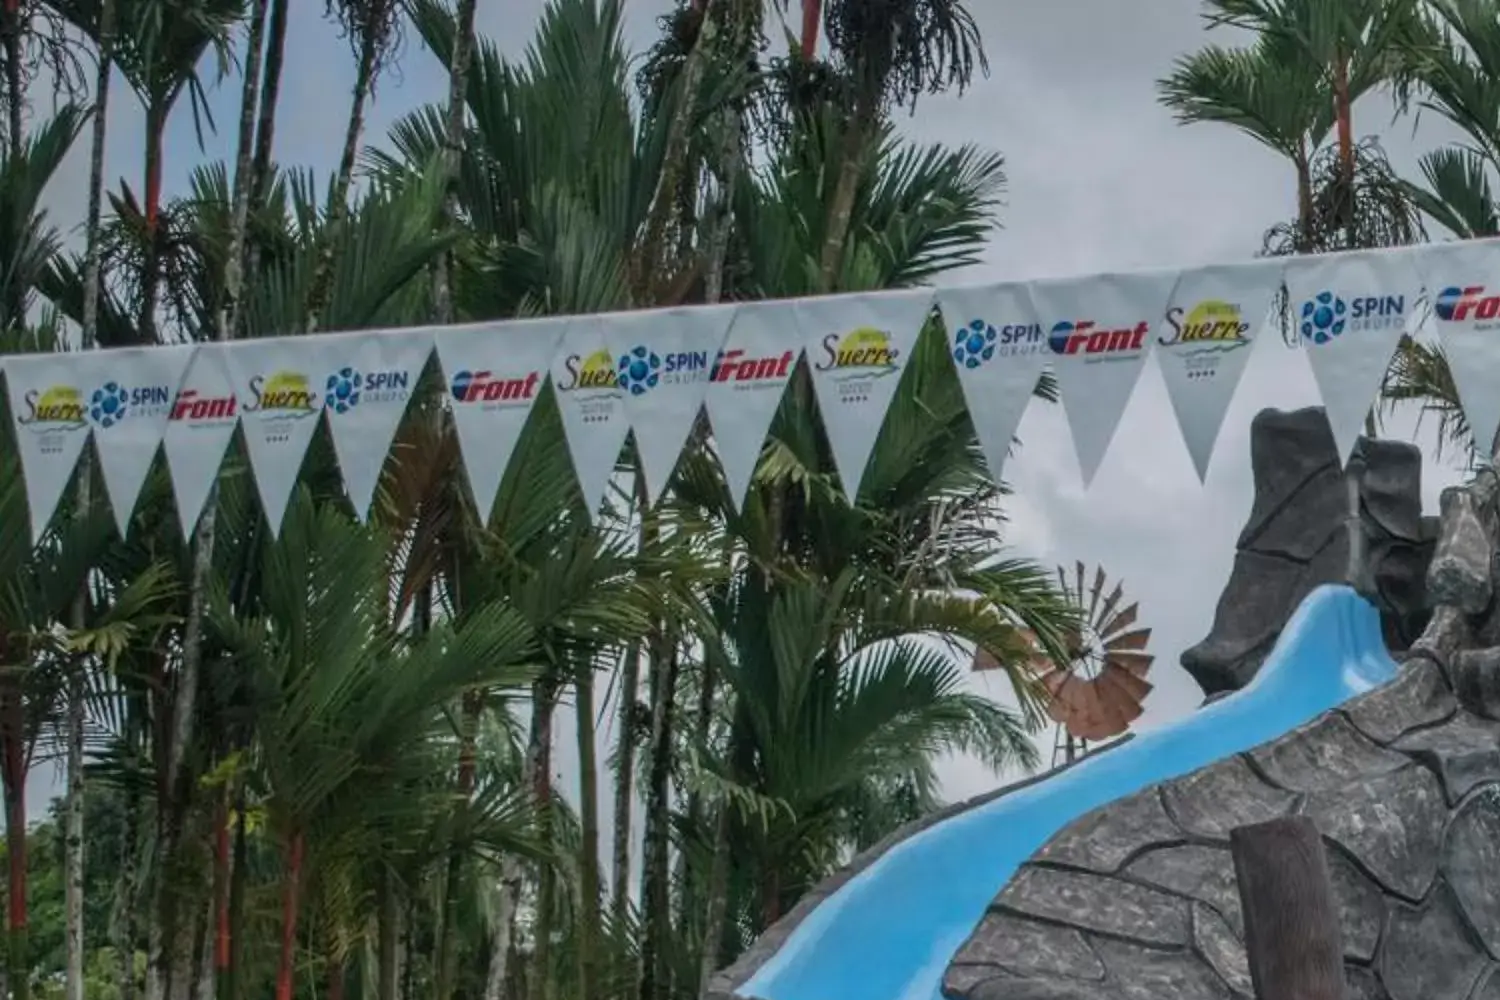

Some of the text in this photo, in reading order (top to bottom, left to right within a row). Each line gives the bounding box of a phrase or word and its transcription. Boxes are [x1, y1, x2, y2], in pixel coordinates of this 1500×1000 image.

[1352, 296, 1404, 318] SPIN
[1066, 320, 1148, 354] Font
[1158, 307, 1249, 345] Suerre
[665, 351, 707, 371] SPIN
[717, 350, 792, 382] Font
[815, 334, 900, 370] Suerre
[365, 371, 408, 390] SPIN
[464, 370, 539, 402] Font
[558, 355, 618, 392] Suer
[131, 386, 168, 405] SPIN
[173, 389, 236, 420] Font
[243, 375, 317, 411] Suerre
